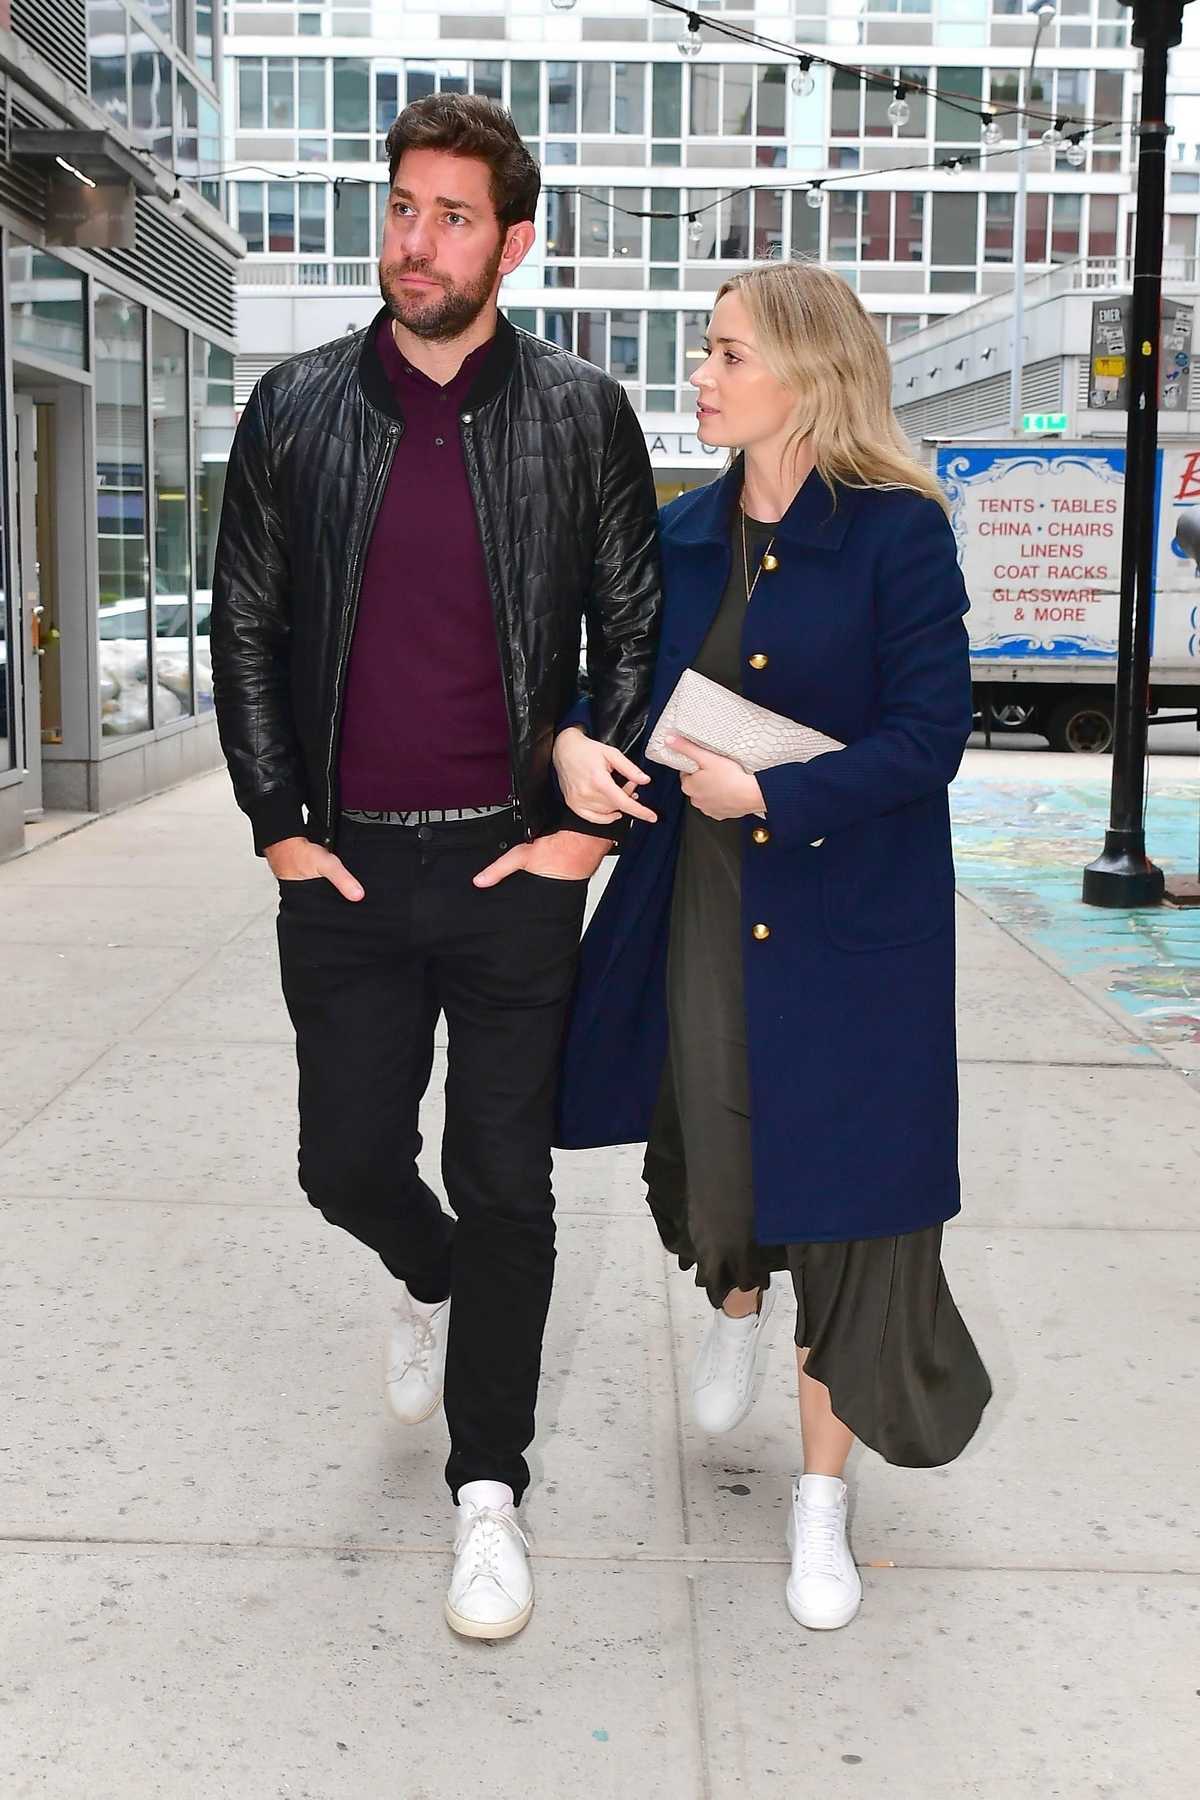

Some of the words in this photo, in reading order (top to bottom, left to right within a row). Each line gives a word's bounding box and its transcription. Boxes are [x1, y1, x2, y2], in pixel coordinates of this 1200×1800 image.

[978, 499, 1035, 513] TENTS
[1051, 499, 1118, 514] TABLES
[978, 522, 1032, 536] CHINA
[1048, 522, 1114, 537] CHAIRS
[1021, 544, 1084, 558] LINENS
[994, 565, 1040, 579] COAT
[1048, 565, 1108, 580] RACKS
[993, 588, 1102, 602] GLASSWARE
[1014, 607, 1025, 621] &
[1034, 607, 1086, 622] MORE
